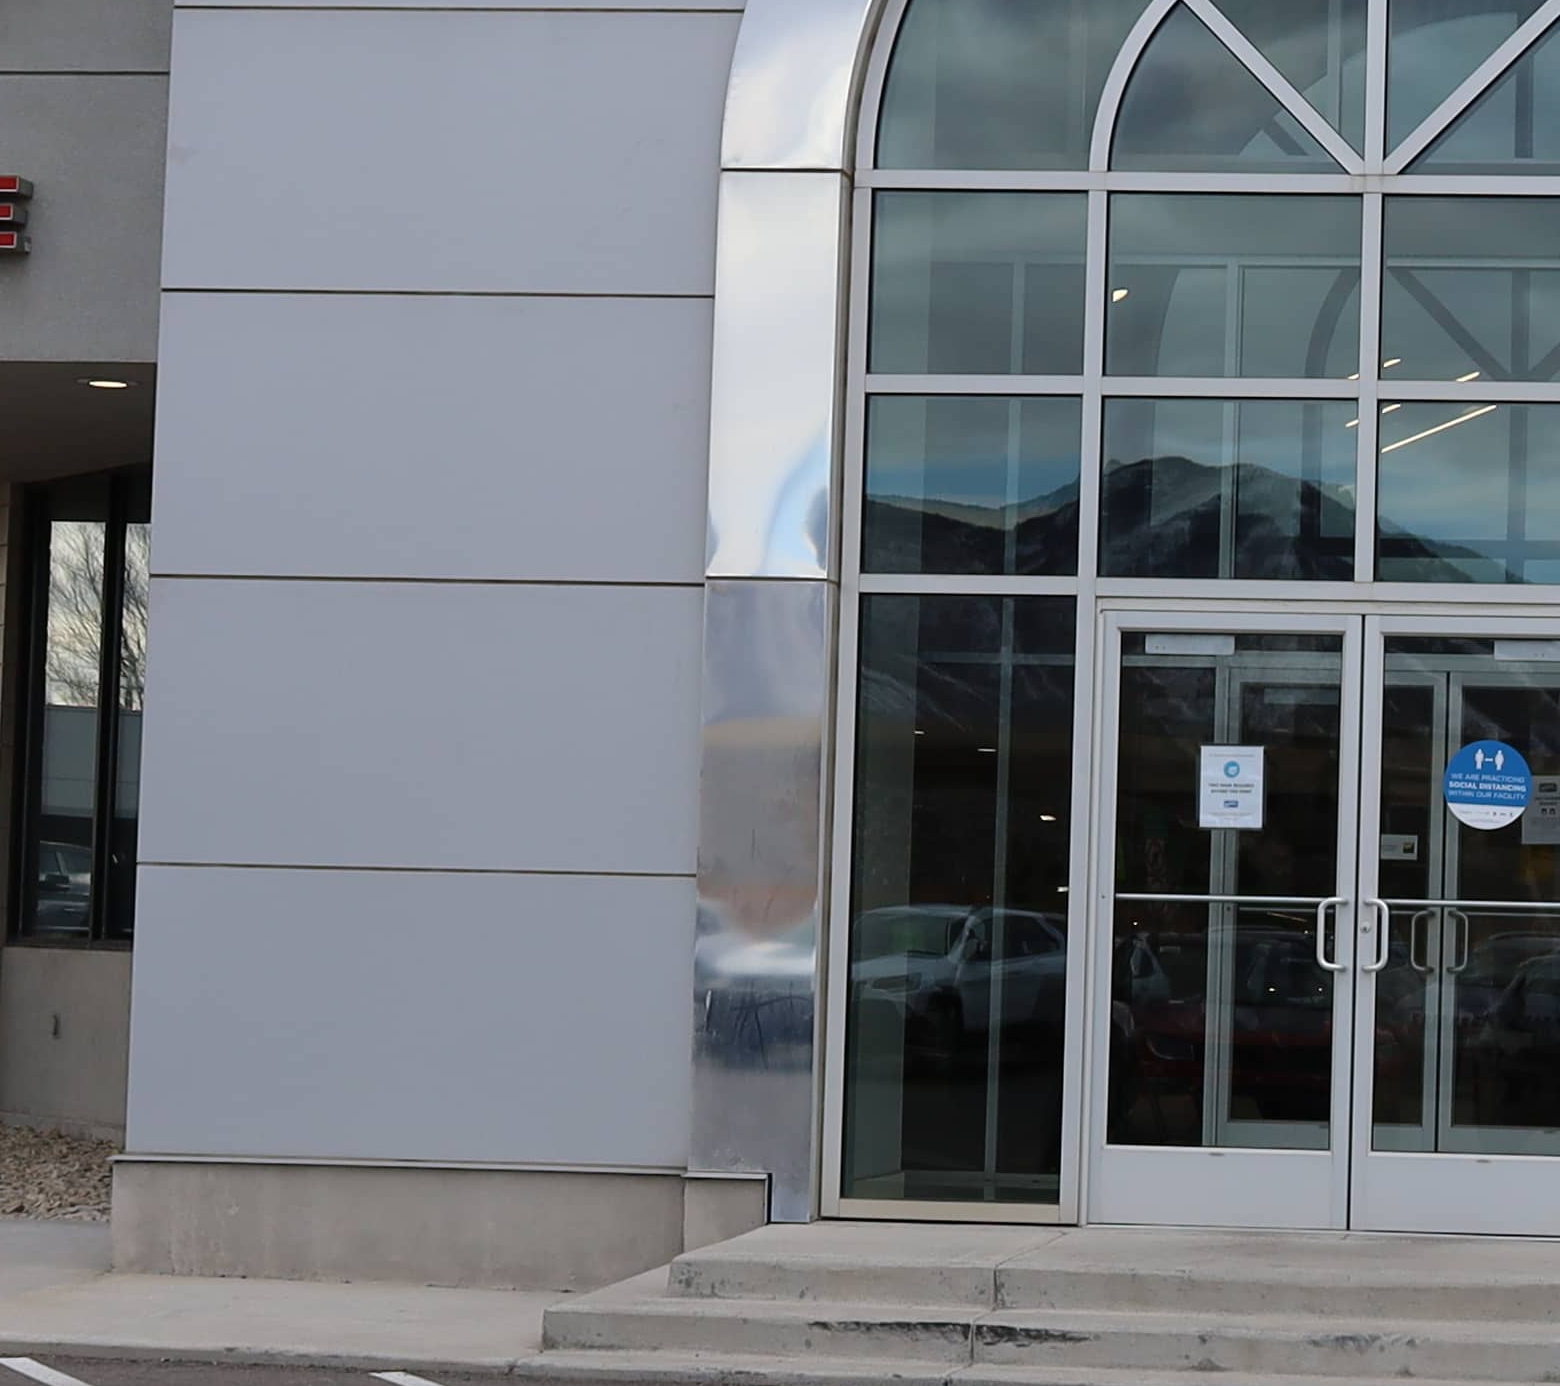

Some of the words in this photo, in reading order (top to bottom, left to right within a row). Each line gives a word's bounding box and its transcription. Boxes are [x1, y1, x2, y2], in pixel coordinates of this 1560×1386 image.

[1450, 772, 1463, 780] WE
[1464, 773, 1480, 781] ARE
[1481, 774, 1526, 784] PRACTICING
[1448, 780, 1477, 790] SOCIAL
[1479, 782, 1527, 793] DISTANCING
[1447, 789, 1475, 798] WITHIN
[1493, 792, 1526, 800] FACILITY
